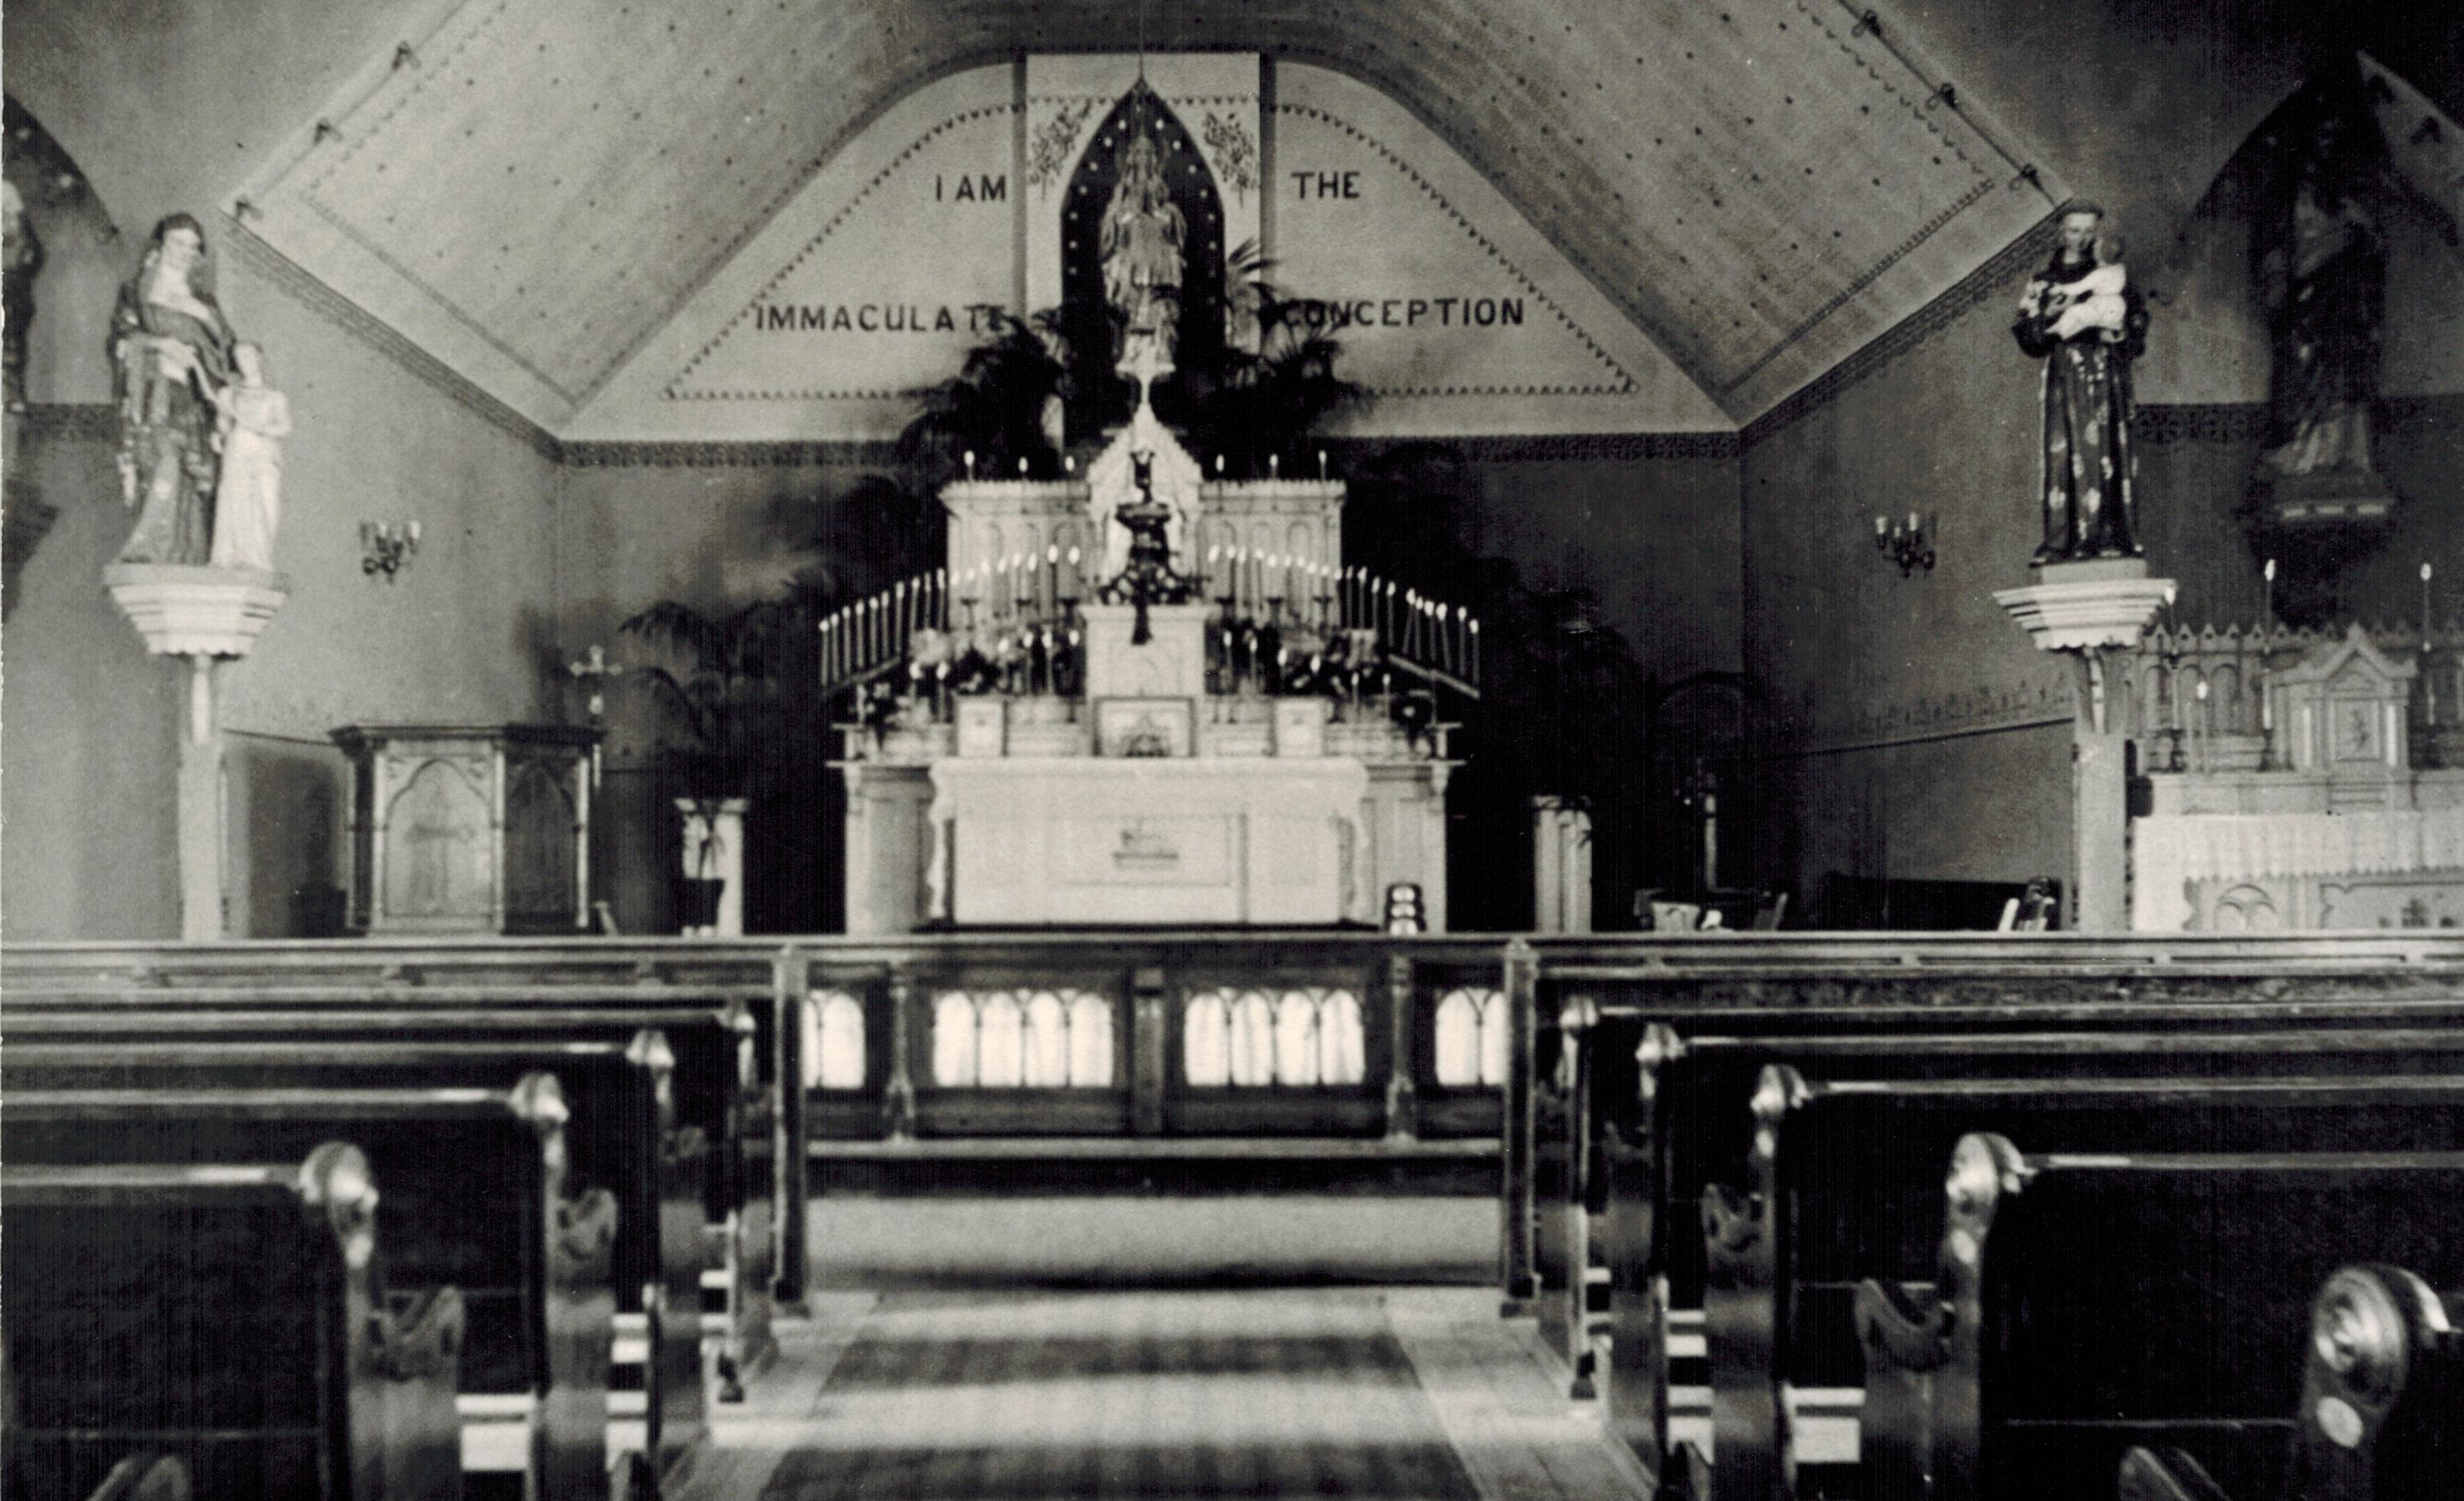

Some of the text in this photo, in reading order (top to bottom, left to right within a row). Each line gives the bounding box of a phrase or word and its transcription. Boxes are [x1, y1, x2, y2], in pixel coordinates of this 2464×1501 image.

[935, 171, 1360, 201] I AM THE
[755, 304, 1005, 332] IMMACULATE
